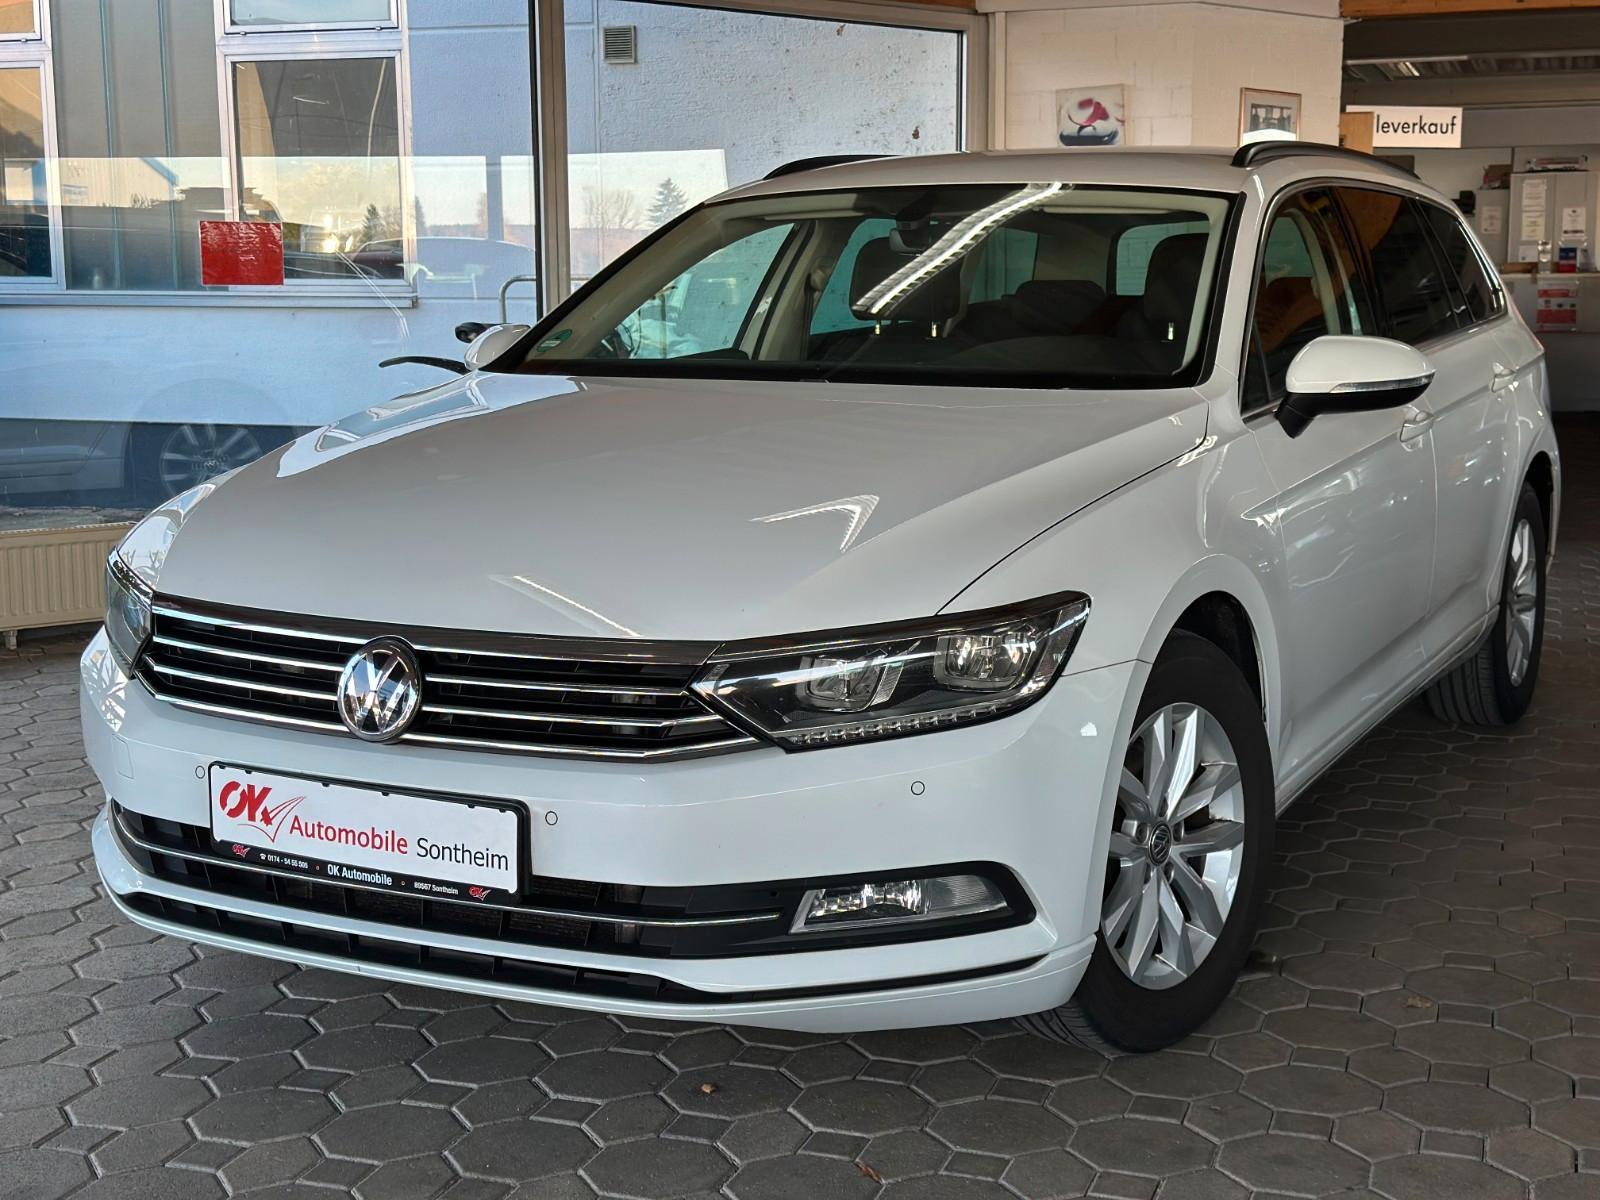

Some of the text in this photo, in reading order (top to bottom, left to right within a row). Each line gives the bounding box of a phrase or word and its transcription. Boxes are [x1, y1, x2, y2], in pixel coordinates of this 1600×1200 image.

[219, 780, 508, 871] OK Automobile Sontheim
[327, 863, 393, 886] OK Automobile
[432, 884, 459, 895] Sontheim
